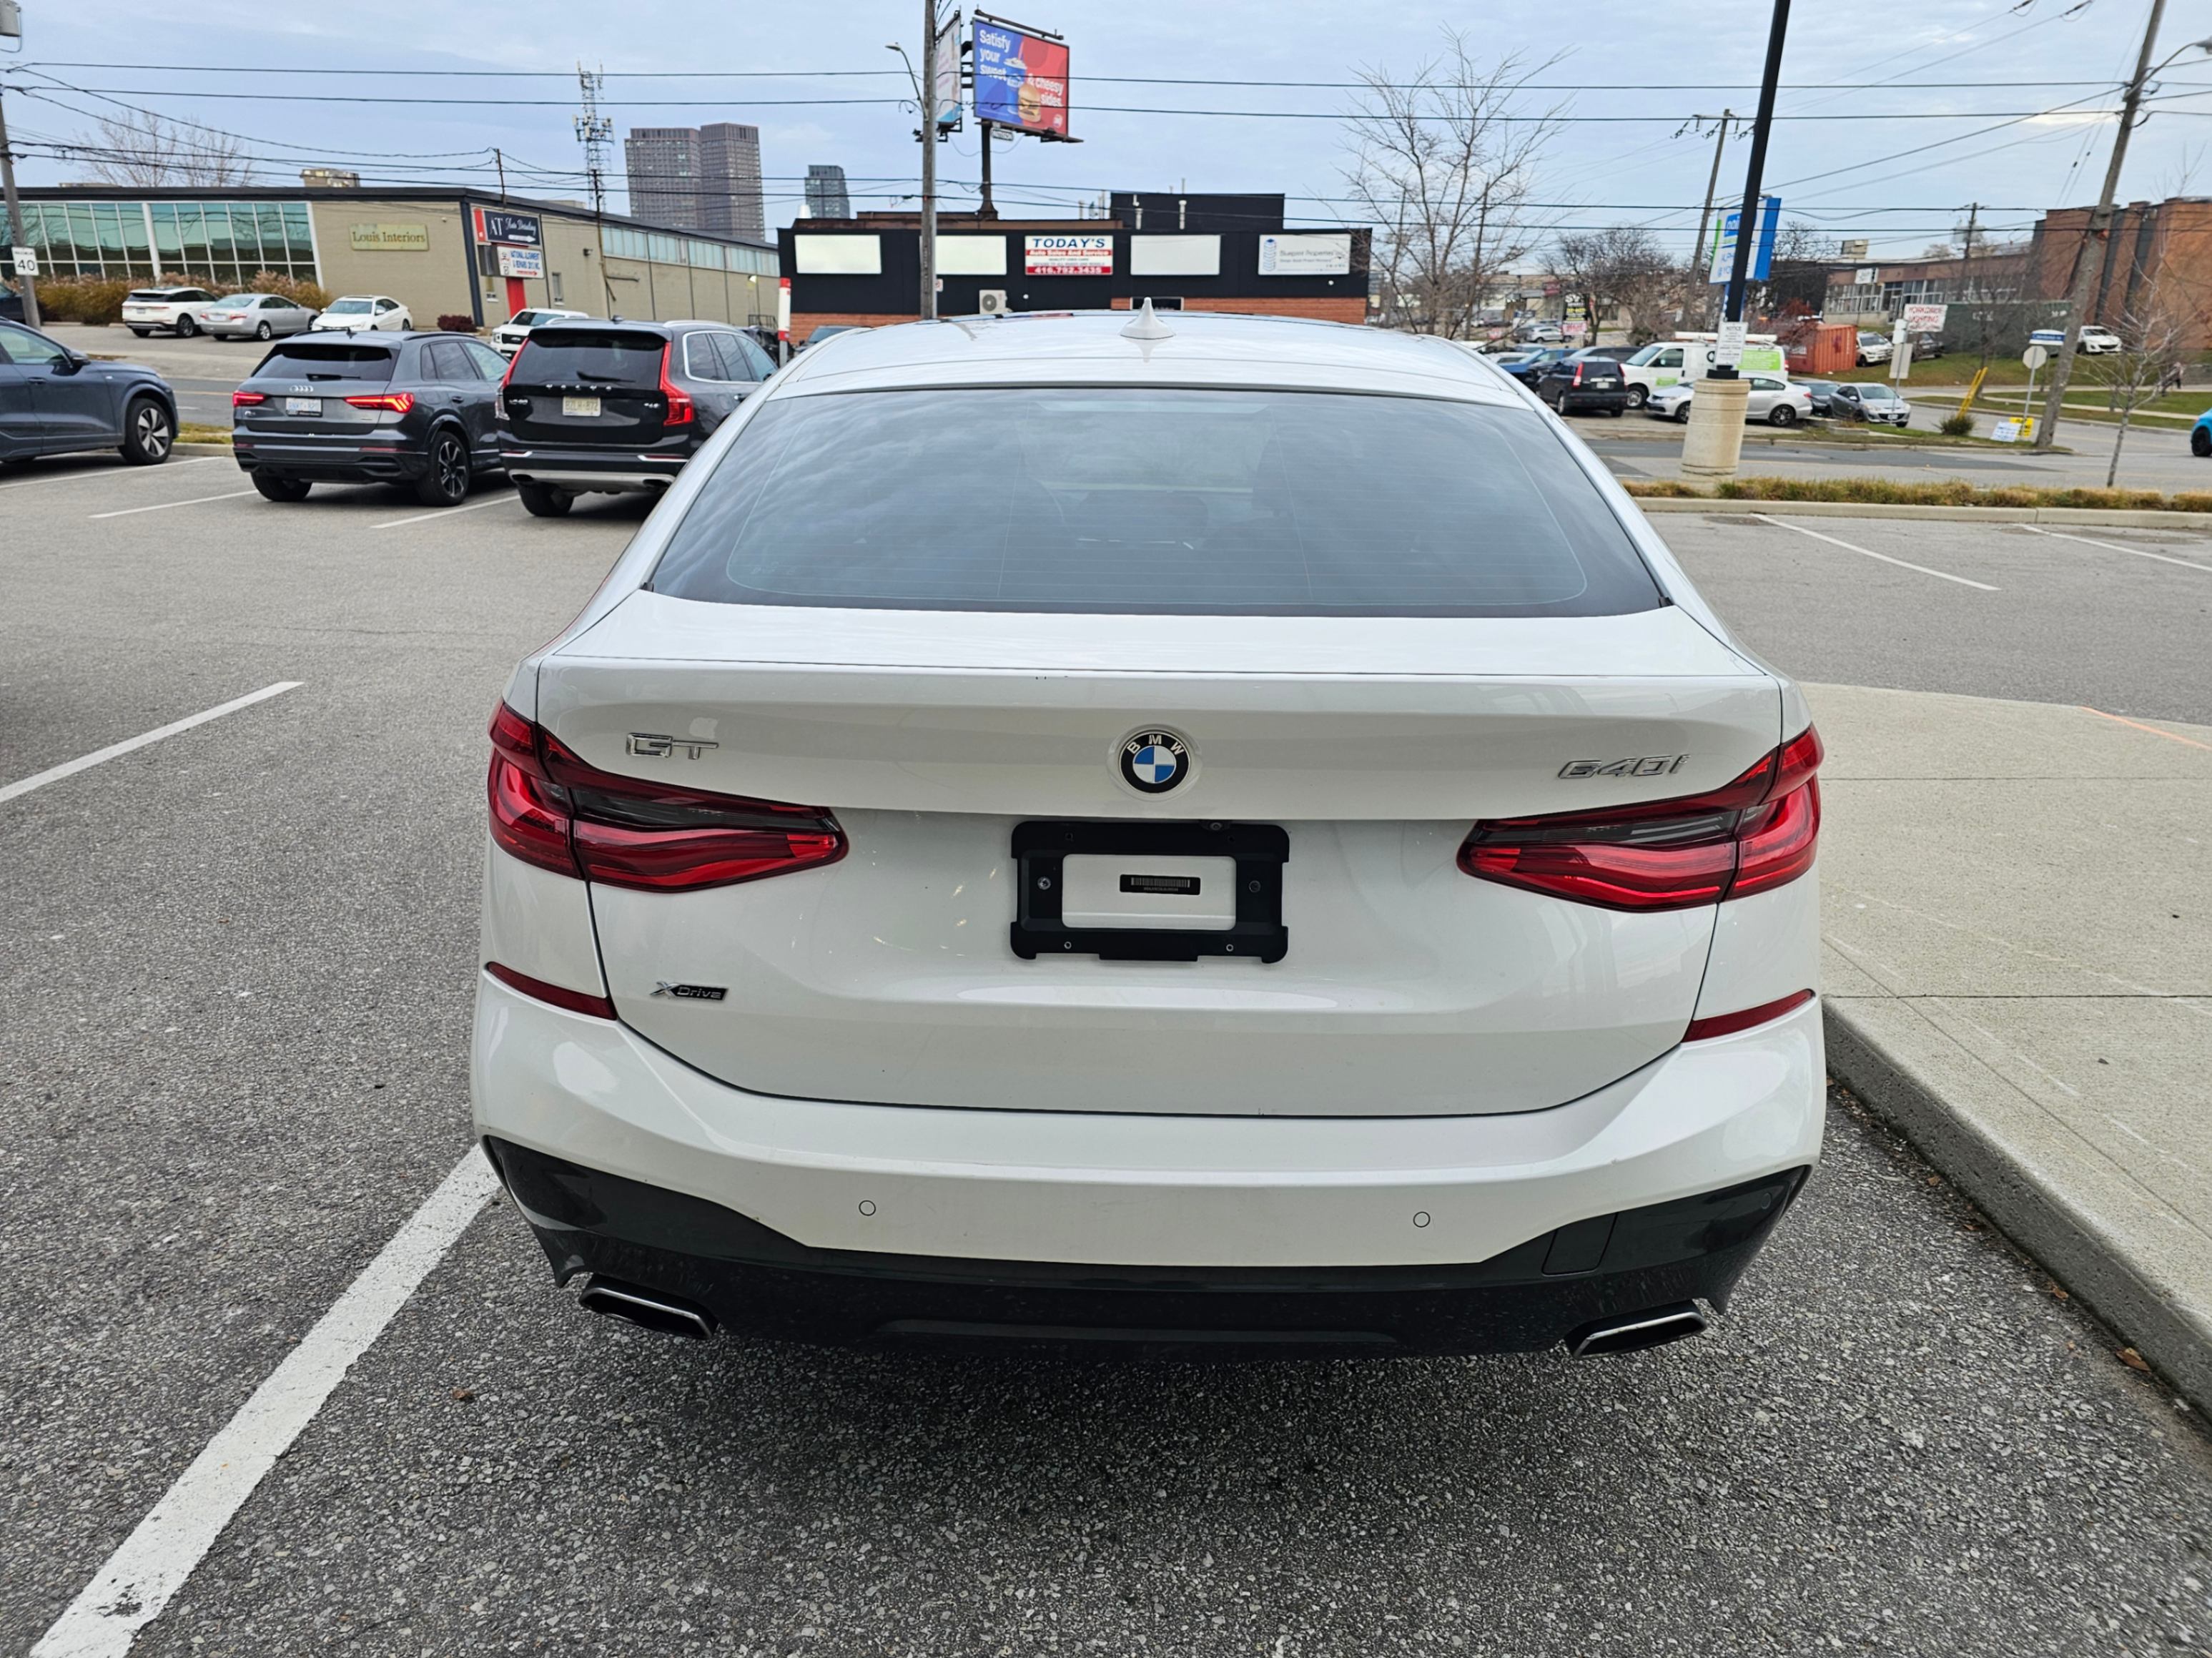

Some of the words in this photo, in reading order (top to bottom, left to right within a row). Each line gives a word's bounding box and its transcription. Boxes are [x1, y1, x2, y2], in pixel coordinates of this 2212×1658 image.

[979, 30, 1011, 53] Satisfy
[979, 48, 1001, 62] your
[980, 64, 1007, 82] sweet
[1027, 73, 1035, 85] &
[1035, 76, 1064, 96] cheesy
[490, 217, 503, 236] AT
[352, 231, 380, 242] Louis
[382, 231, 425, 242] Interiors
[1032, 238, 1105, 248] TODAY'S
[18, 260, 35, 271] 40
[626, 732, 719, 760] GT
[1127, 734, 1185, 755] BMW
[1558, 754, 1692, 779] 640i
